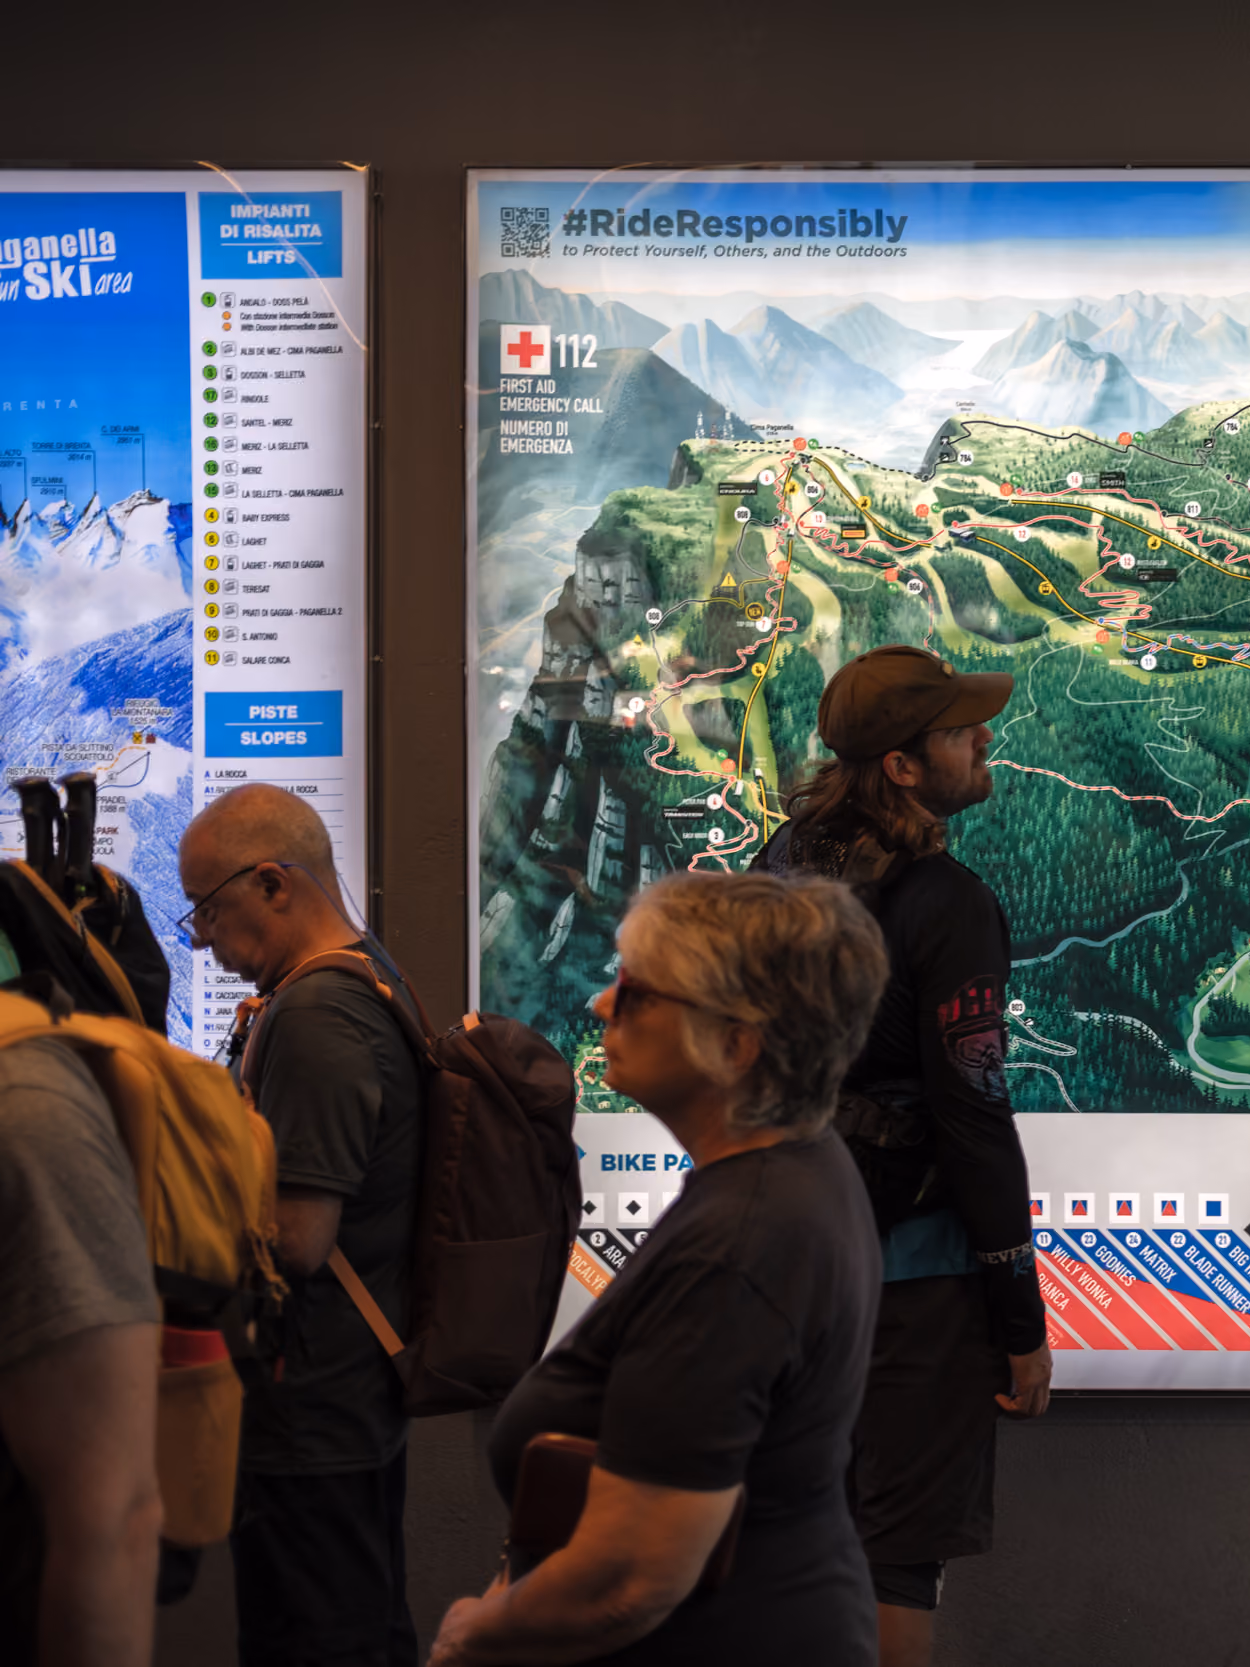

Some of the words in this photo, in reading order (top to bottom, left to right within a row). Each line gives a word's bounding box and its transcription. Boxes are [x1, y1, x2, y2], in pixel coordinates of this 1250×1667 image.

[231, 204, 310, 218] IMPIANTI
[221, 225, 241, 238] DI
[245, 223, 322, 238] RISALITA
[563, 208, 908, 243] #RideResponsibly
[0, 228, 116, 268] ganella
[563, 245, 578, 257] to
[583, 244, 638, 257] Protect
[645, 244, 708, 259] Yourself,
[714, 245, 768, 259] Others,
[773, 245, 802, 257] and
[806, 244, 830, 257] the
[836, 245, 907, 257] Outdoors
[248, 251, 296, 264] LIFTS
[95, 271, 133, 295] area
[240, 298, 266, 306] ANDALO
[305, 346, 343, 354] PAGANELLA
[556, 334, 597, 368] 112
[501, 379, 533, 393] FIRST
[537, 379, 556, 393] AID
[501, 397, 571, 413] EMERGENCY
[574, 398, 603, 413] CALL
[206, 416, 216, 424] 12
[1226, 423, 1238, 431] 784
[501, 420, 552, 436] NUMERO
[556, 420, 568, 436] DI
[766, 425, 793, 433] Paganella
[278, 442, 309, 450] SELLETTA
[501, 438, 573, 454] EMERGENZA
[960, 454, 971, 462] 784
[207, 464, 216, 472] 13
[252, 490, 282, 498] SELLETTA
[289, 489, 305, 497] CIMA
[307, 488, 343, 497] PAGANELLA
[242, 514, 258, 522] BABY
[261, 514, 290, 522] EXPRESS
[242, 538, 267, 546] LAGHET
[301, 560, 324, 568] GAGGIA
[1124, 558, 1131, 566] 12
[300, 608, 336, 616] PAGANELLA
[207, 630, 216, 638] 10
[249, 706, 298, 719] PISTE
[241, 731, 307, 745] SLOPES
[601, 1154, 656, 1171] BIKE
[664, 1154, 695, 1171] PA
[1129, 1234, 1139, 1245] 24
[1139, 1245, 1178, 1283] MATRIX
[1173, 1235, 1183, 1245] 22
[1184, 1246, 1213, 1277] BLADE
[1218, 1236, 1228, 1246] 21
[1228, 1246, 1249, 1267] BIG
[1084, 1234, 1094, 1245] 23
[1095, 1245, 1137, 1287] GOONIES
[1040, 1235, 1048, 1245] 11
[1050, 1244, 1079, 1277] WILLY
[1077, 1275, 1113, 1310] WONKA
